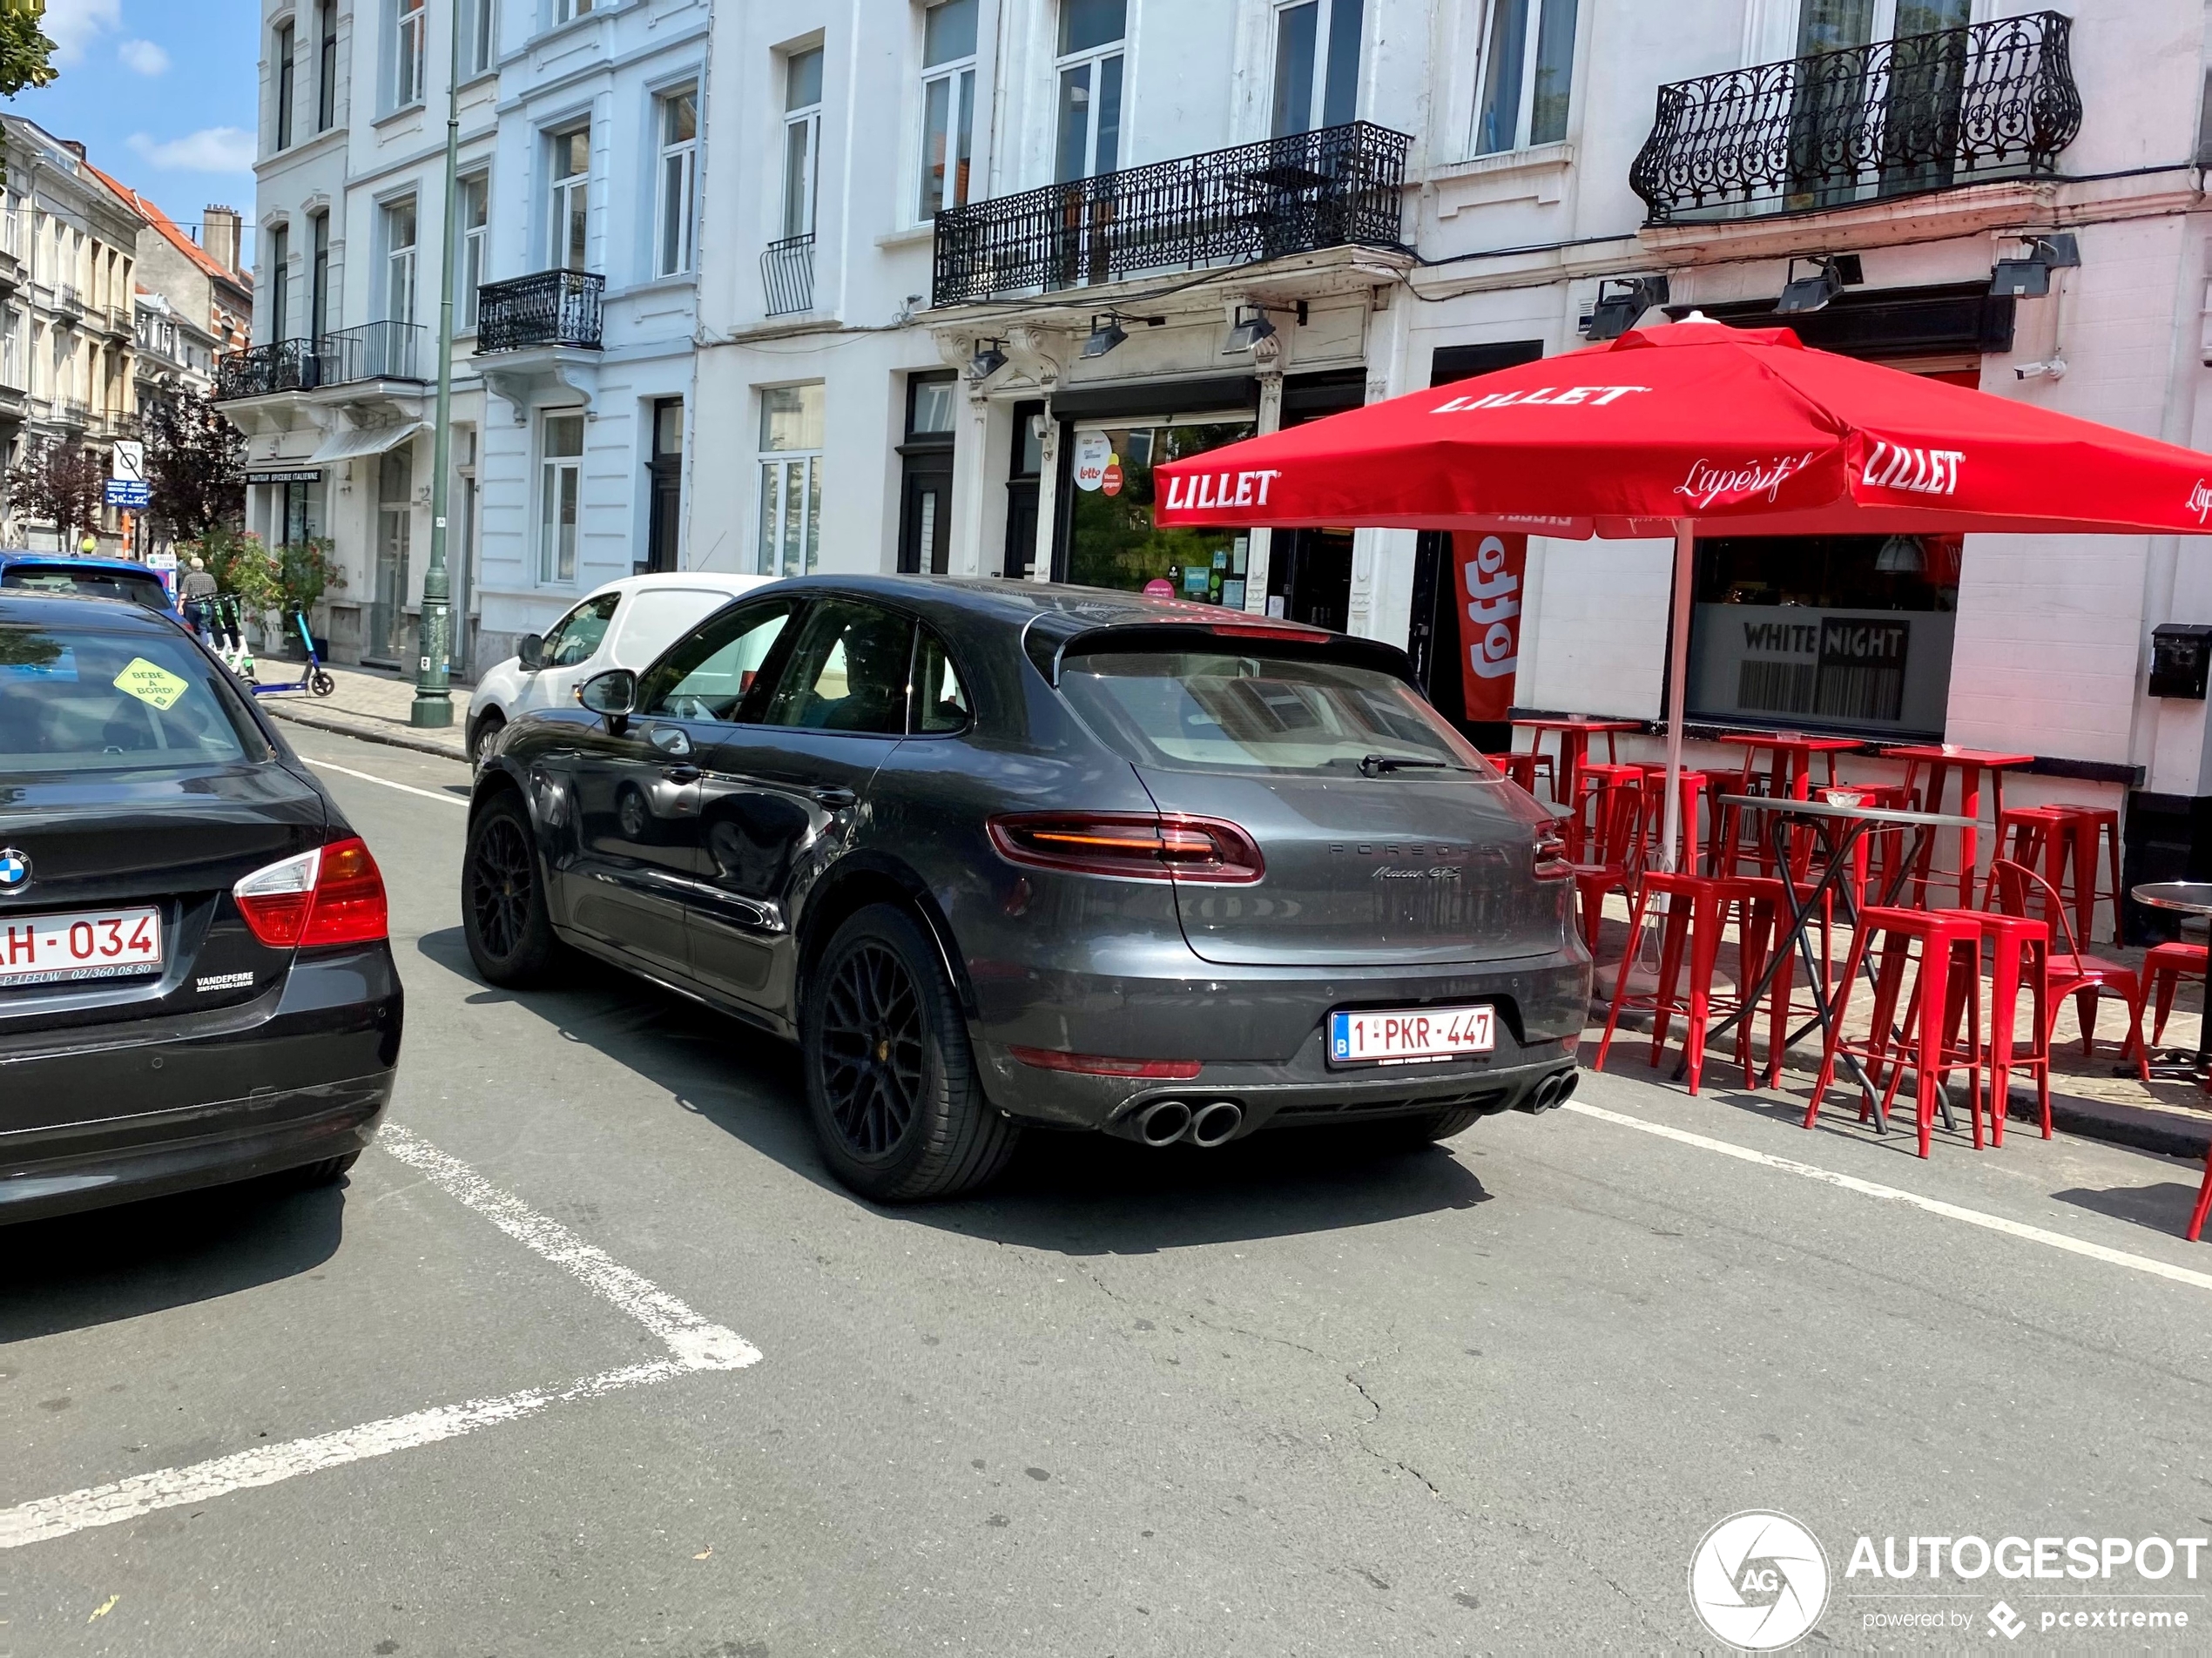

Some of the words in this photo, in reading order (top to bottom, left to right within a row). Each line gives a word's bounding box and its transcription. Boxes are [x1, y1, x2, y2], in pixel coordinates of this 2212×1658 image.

[1429, 386, 1646, 414] LILLET
[1862, 441, 1963, 495] LILLET
[1165, 470, 1278, 510] LILLET
[1743, 622, 1817, 652] WHITE
[1825, 626, 1903, 657] NIGHT
[1328, 843, 1500, 856] PORSCHE
[1372, 866, 1425, 880] Macan
[1427, 866, 1462, 880] GTS
[135, 964, 152, 974] 80
[196, 972, 253, 986] VANDEPERRE
[1337, 1039, 1347, 1055] B
